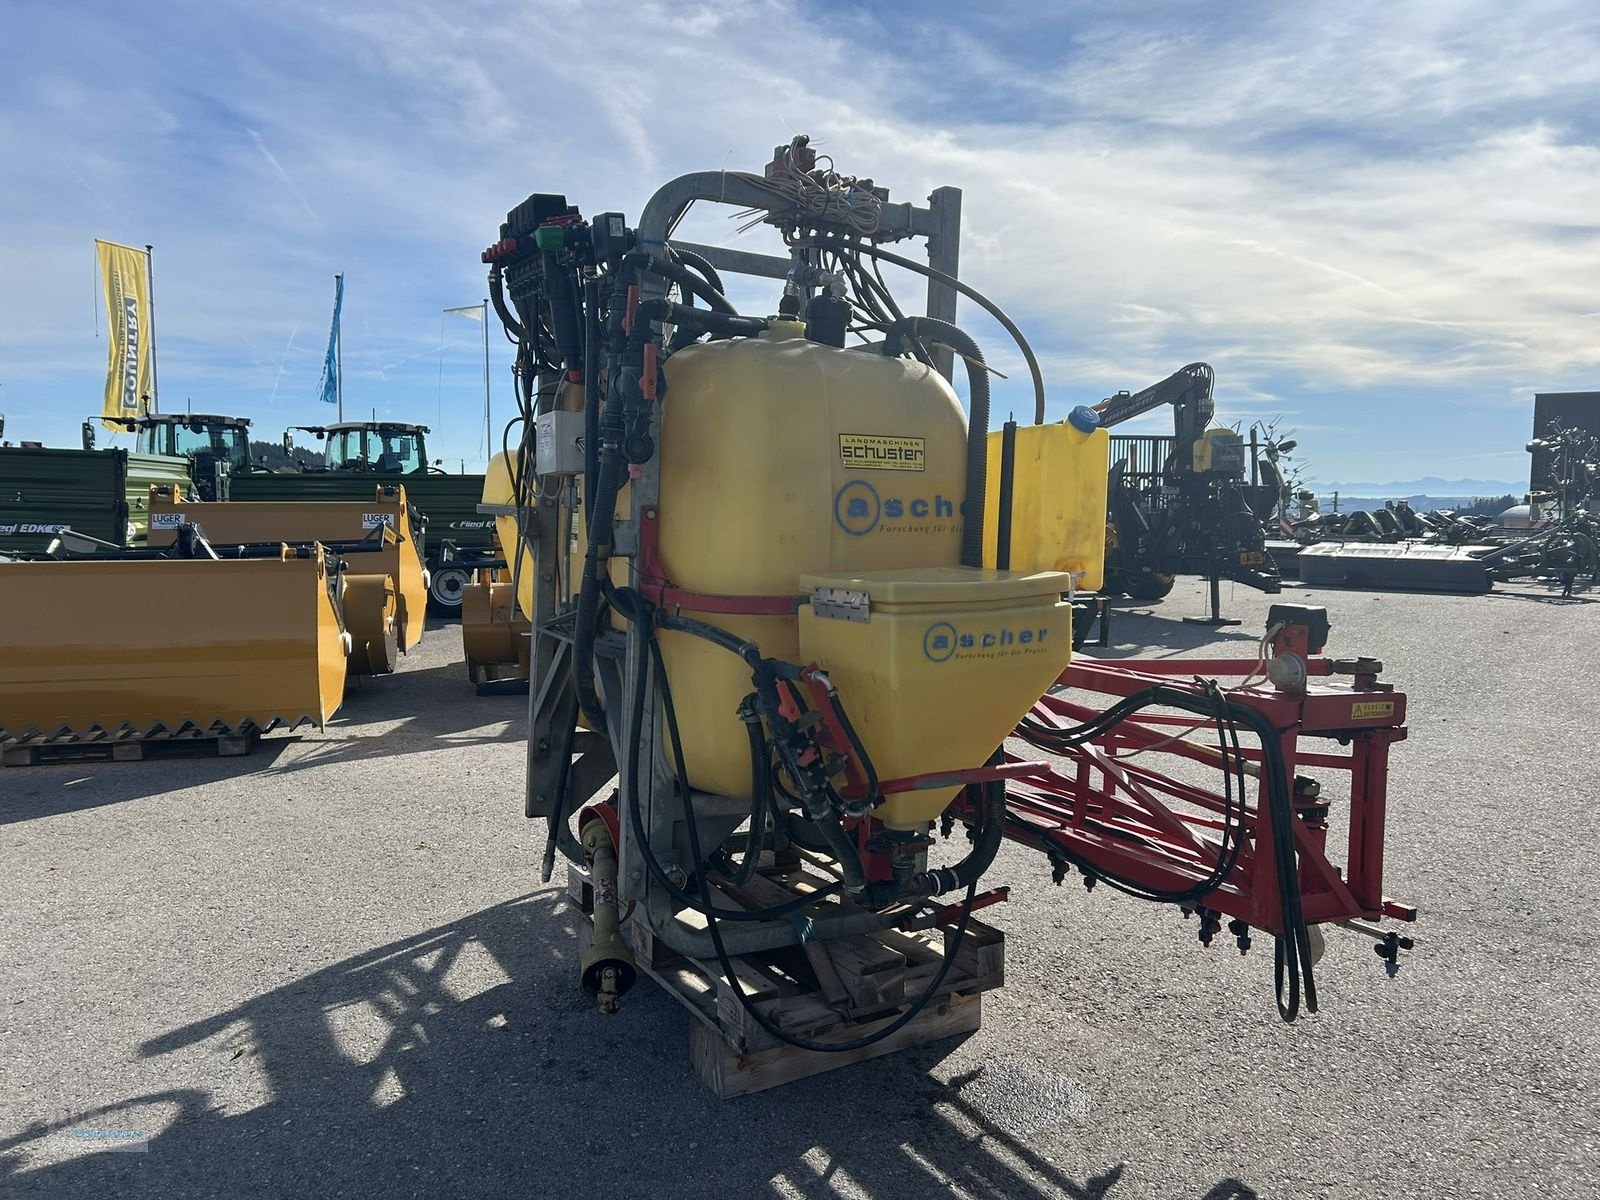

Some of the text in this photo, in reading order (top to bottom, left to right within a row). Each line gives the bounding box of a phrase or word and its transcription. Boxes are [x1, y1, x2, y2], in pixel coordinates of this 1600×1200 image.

[845, 438, 920, 447] LANDMASCHINEN
[842, 445, 923, 461] schuster
[153, 514, 181, 523] LUGER
[363, 514, 390, 522] LUGER
[19, 524, 47, 533] EDK
[879, 524, 931, 534] Forschung
[934, 524, 947, 534] für
[931, 628, 1047, 650] ascher
